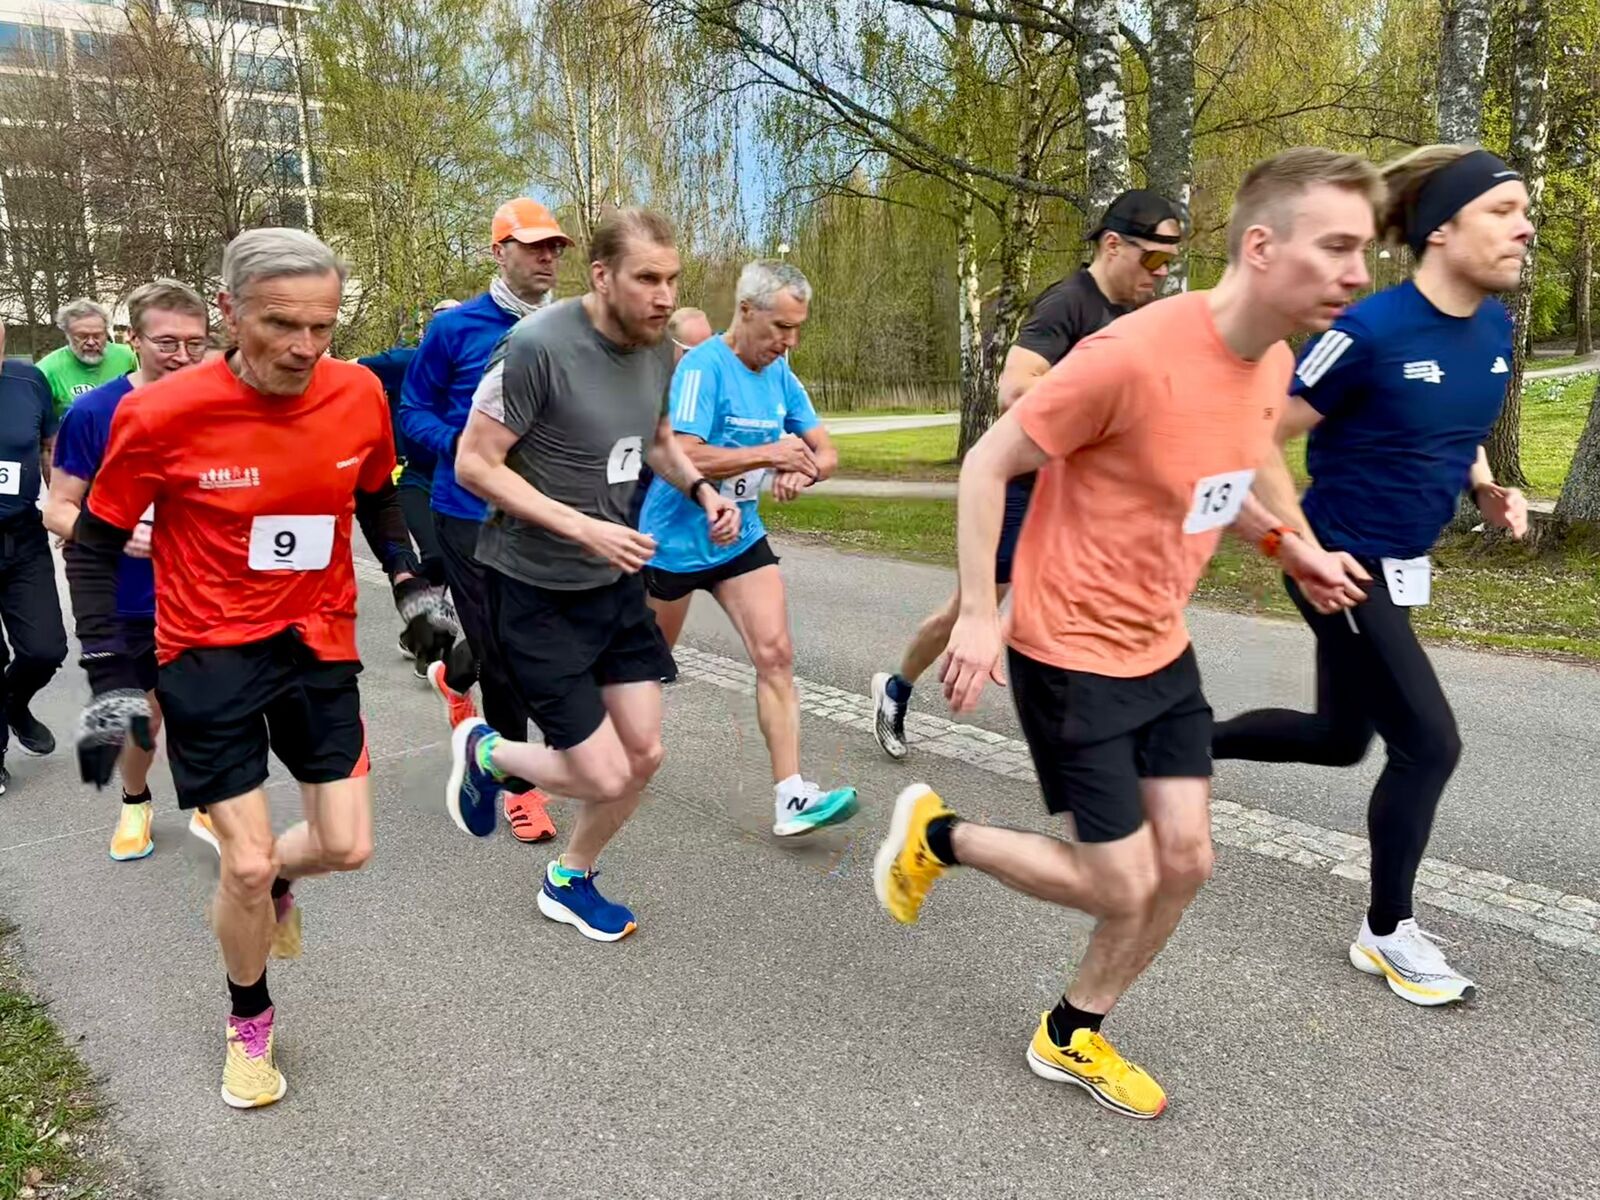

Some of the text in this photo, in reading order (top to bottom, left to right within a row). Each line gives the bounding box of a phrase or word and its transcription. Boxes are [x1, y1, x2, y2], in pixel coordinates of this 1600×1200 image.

[620, 448, 634, 470] 7
[734, 478, 747, 496] 6
[1202, 483, 1232, 514] 13
[273, 530, 297, 557] 9
